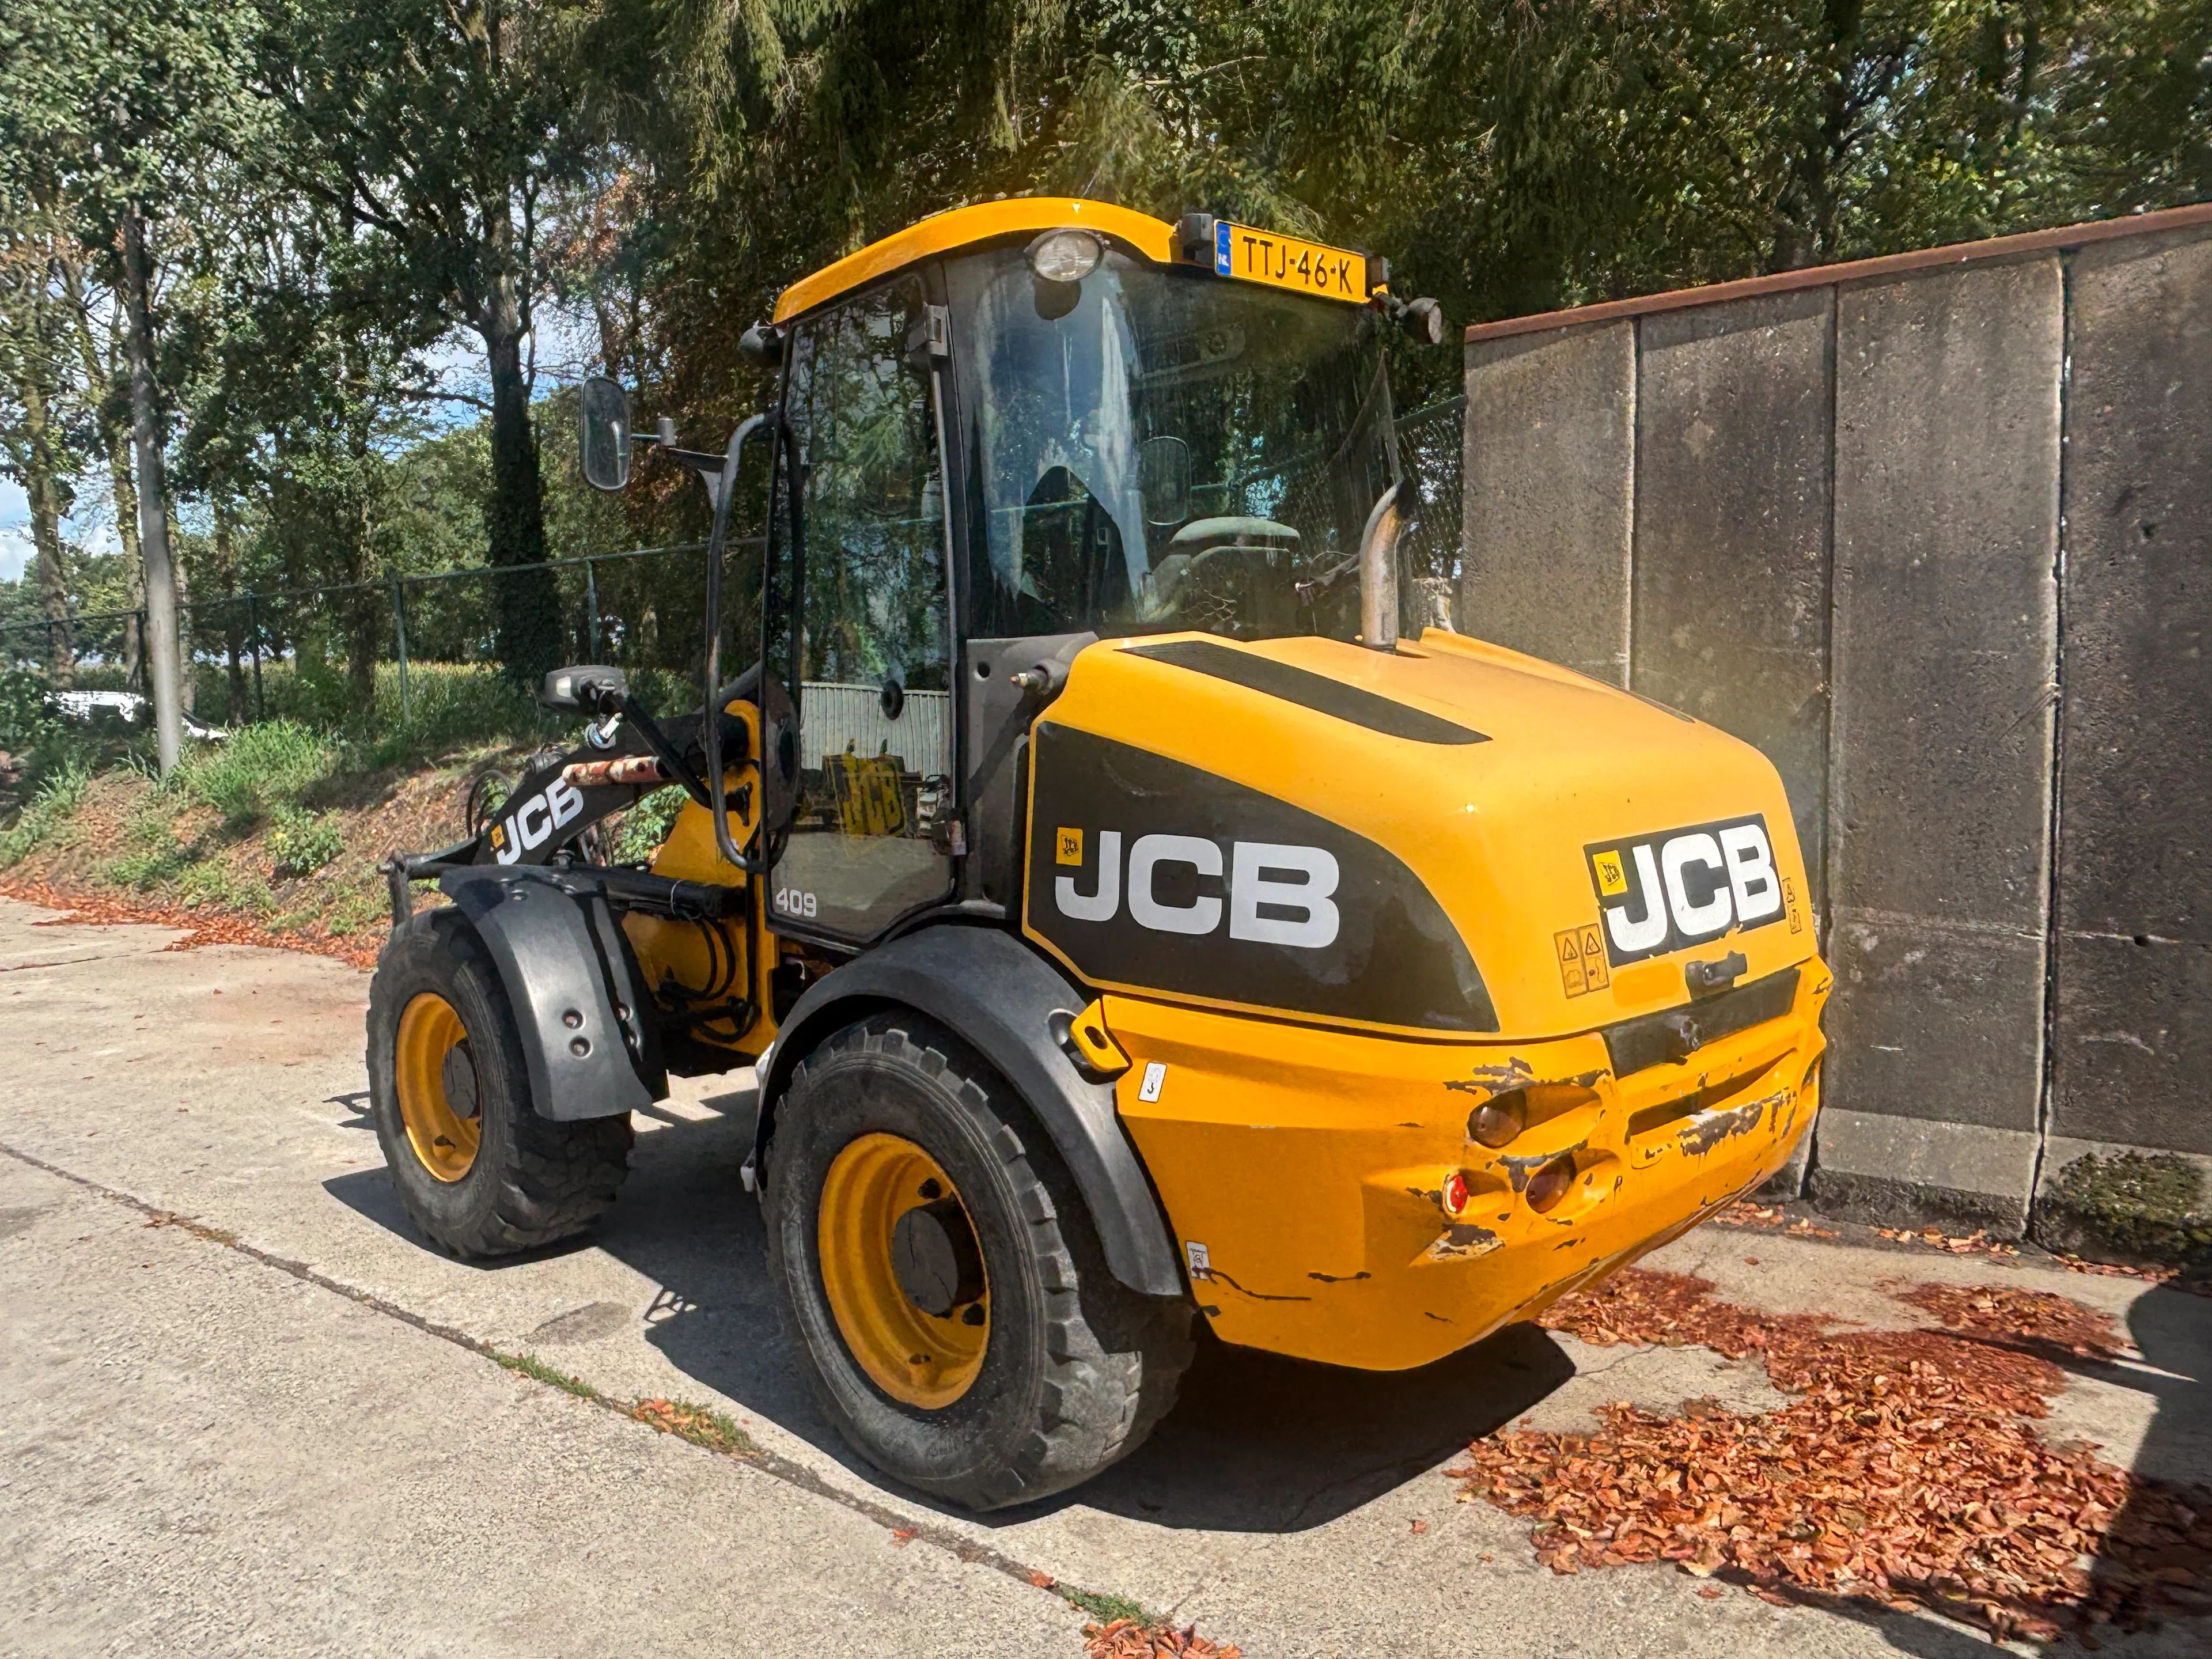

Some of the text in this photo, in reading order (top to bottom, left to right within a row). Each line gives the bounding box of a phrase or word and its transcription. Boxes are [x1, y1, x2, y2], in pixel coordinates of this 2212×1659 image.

[1243, 236, 1352, 294] TTJ-46-K
[497, 776, 584, 865] JCB
[776, 888, 817, 918] 409
[1055, 831, 1340, 948] JCB
[1607, 824, 1781, 952] JCB
